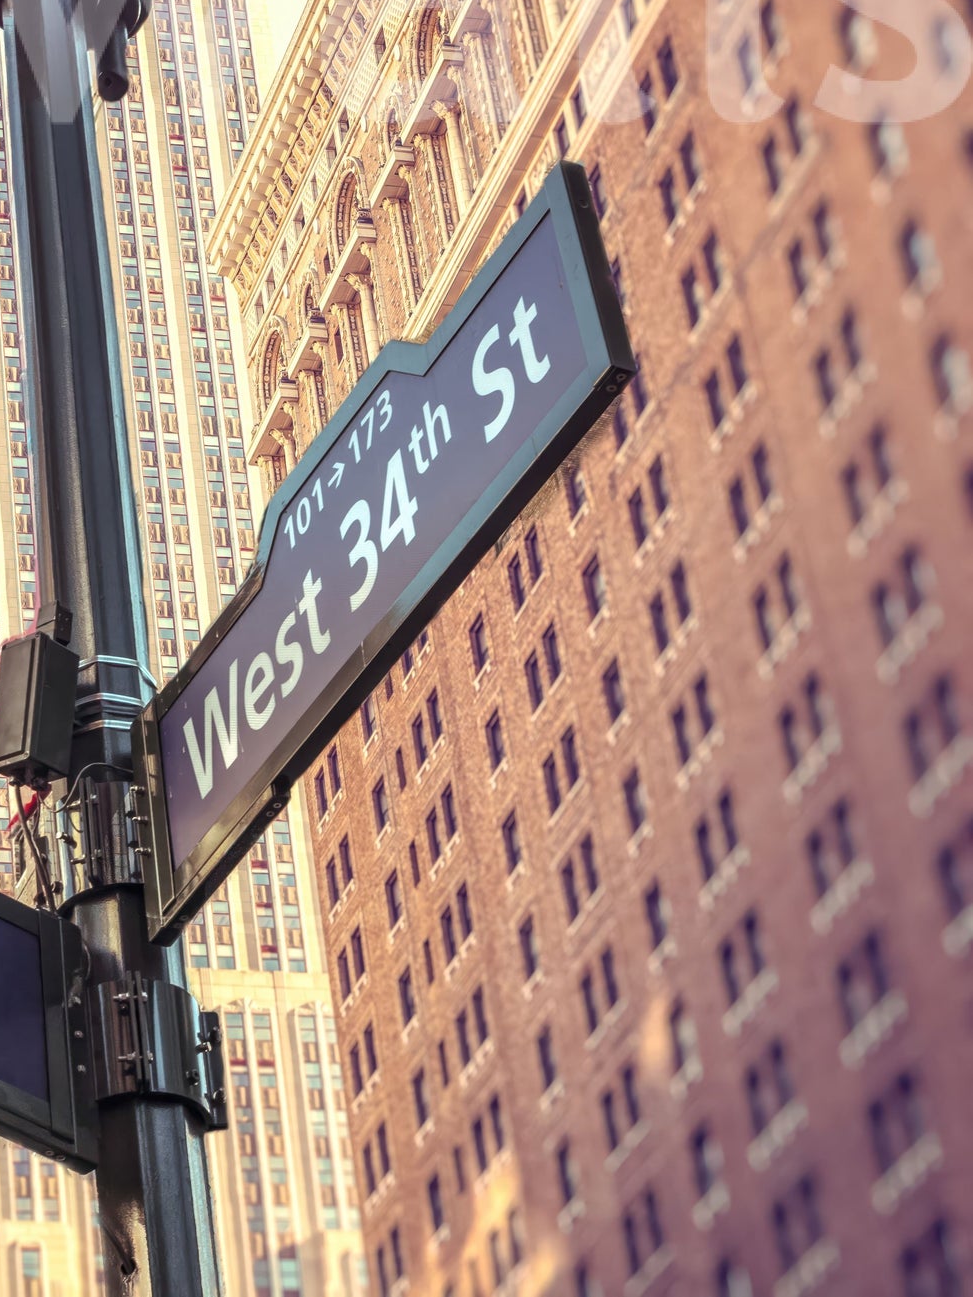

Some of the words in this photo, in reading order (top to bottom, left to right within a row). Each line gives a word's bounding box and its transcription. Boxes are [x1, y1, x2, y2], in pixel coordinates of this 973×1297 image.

[182, 567, 332, 800] West
[339, 400, 452, 613] 34th
[471, 295, 551, 444] St
[283, 477, 325, 550] 101
[347, 393, 393, 464] 173
